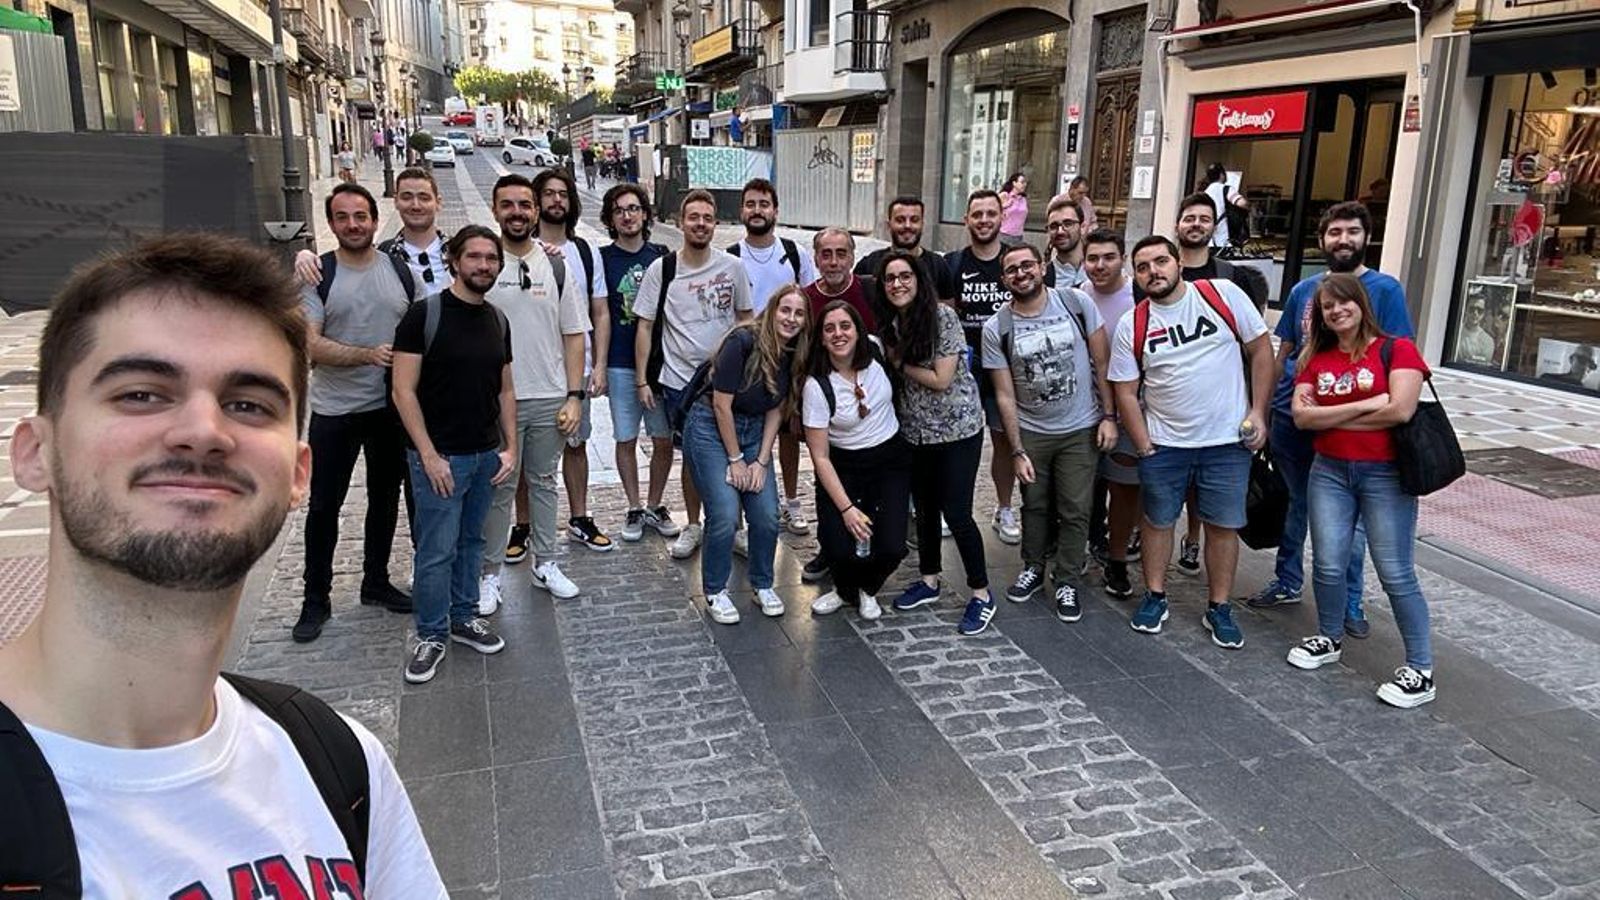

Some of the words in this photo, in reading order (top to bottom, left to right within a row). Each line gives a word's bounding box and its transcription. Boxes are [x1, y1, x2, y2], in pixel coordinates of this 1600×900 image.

[963, 282, 998, 292] NIKE
[961, 291, 1013, 302] MOVING
[1147, 315, 1218, 354] FILA
